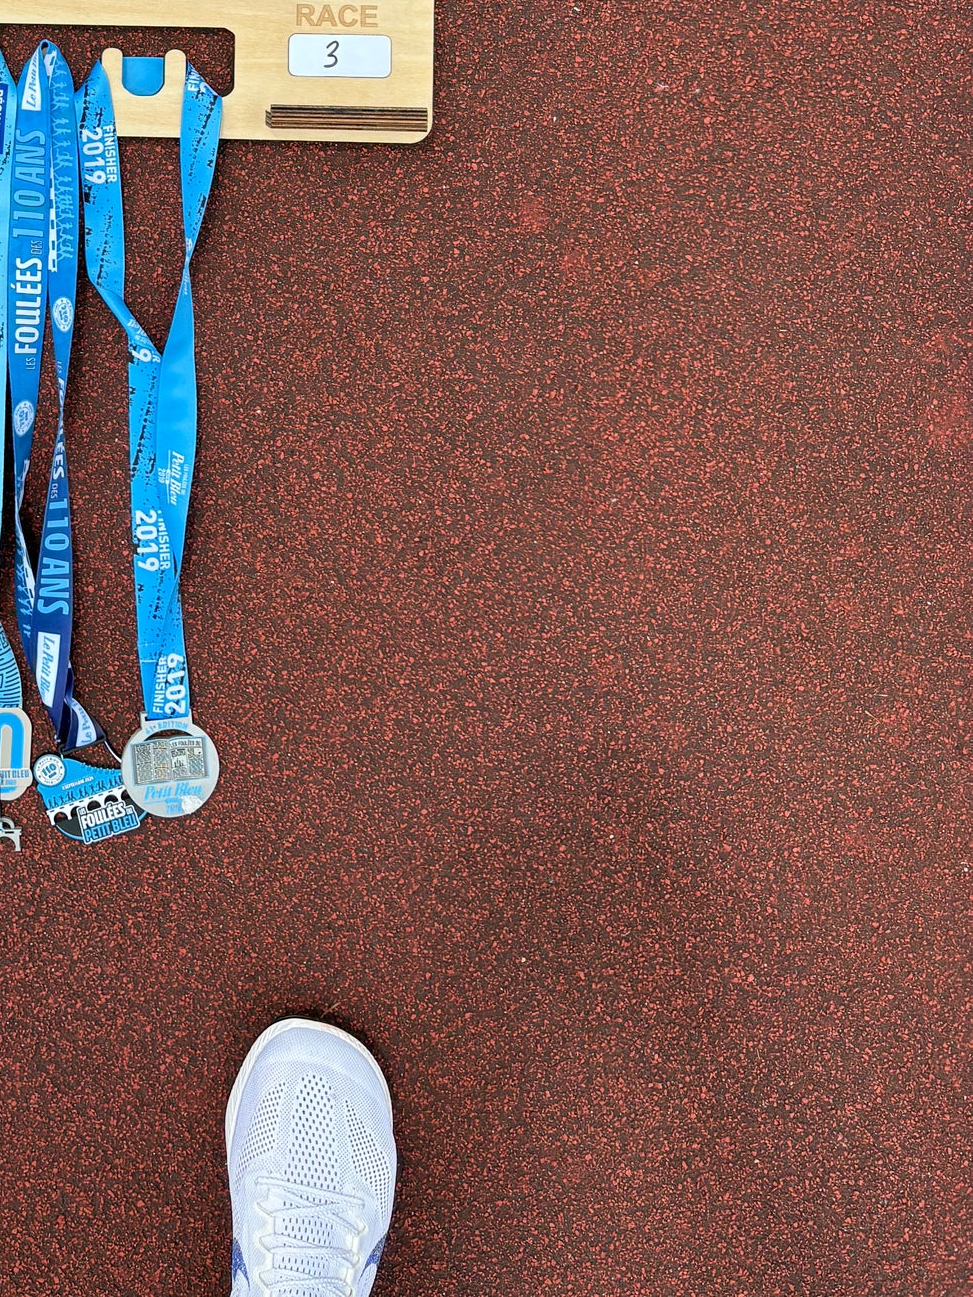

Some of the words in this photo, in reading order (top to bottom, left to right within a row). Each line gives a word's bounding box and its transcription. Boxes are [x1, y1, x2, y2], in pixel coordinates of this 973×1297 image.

[296, 3, 379, 28] RACE
[323, 40, 340, 68] 3
[14, 129, 46, 186] ANS
[80, 127, 107, 185] 2019
[102, 125, 118, 183] FINISHER
[13, 189, 45, 239] 110
[30, 240, 43, 255] DES
[10, 258, 43, 354] FOULÉES
[26, 357, 35, 370] LES
[171, 451, 185, 480] Petit
[50, 483, 59, 499] DES
[170, 479, 182, 506] Bleu
[135, 509, 160, 573] 2019
[37, 557, 70, 616] ANS
[42, 635, 55, 653] Le
[40, 653, 54, 681] Petit
[153, 655, 168, 713] FINISHER
[164, 653, 186, 715] 2019
[144, 785, 173, 801] Petit
[174, 782, 203, 797] Bleu
[80, 802, 125, 830] FOULÉES
[84, 825, 110, 843] PETIT
[112, 815, 138, 833] BLEU
